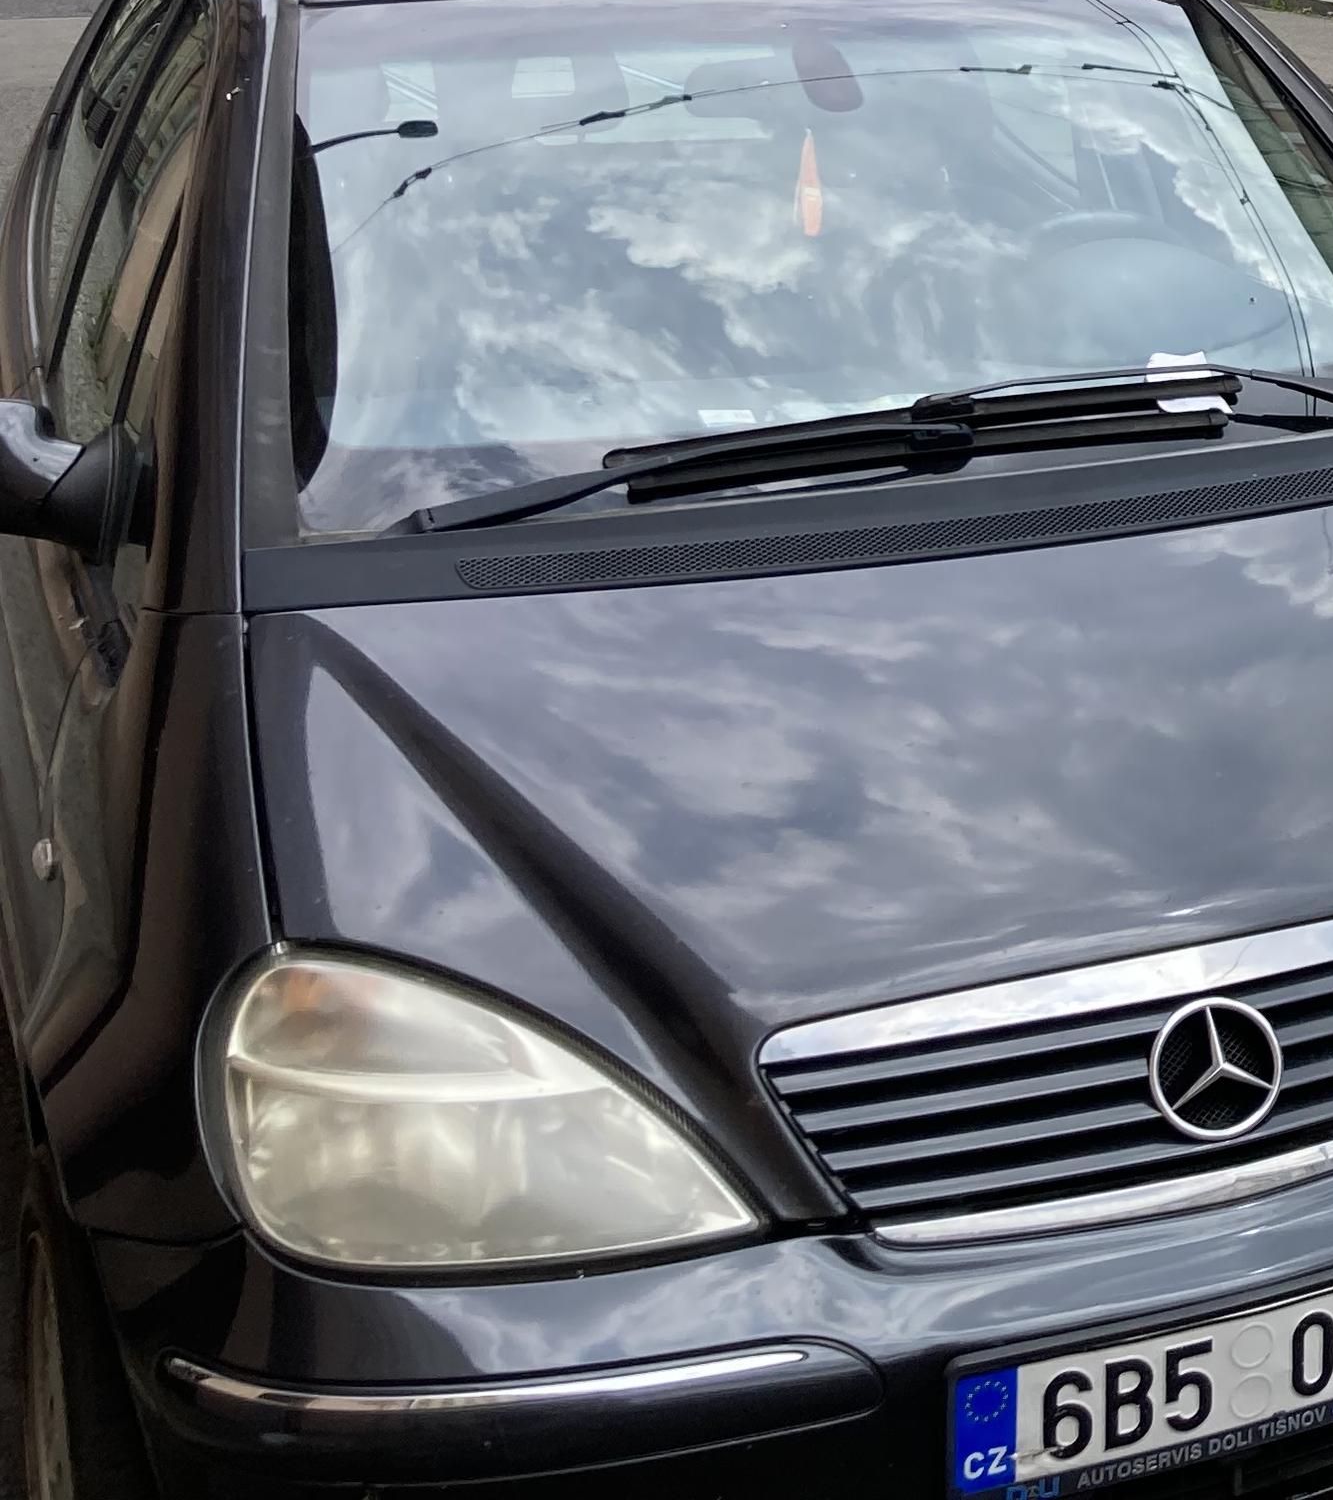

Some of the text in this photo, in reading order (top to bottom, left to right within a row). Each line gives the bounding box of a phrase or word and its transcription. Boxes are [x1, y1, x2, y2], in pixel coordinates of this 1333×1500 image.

[1042, 1338, 1214, 1460] 6B5
[963, 1446, 1008, 1481] CZ
[1076, 1443, 1202, 1490] AUTOSERVIS
[1207, 1429, 1253, 1456] DOLI
[1257, 1405, 1327, 1441] TIŠNOV
